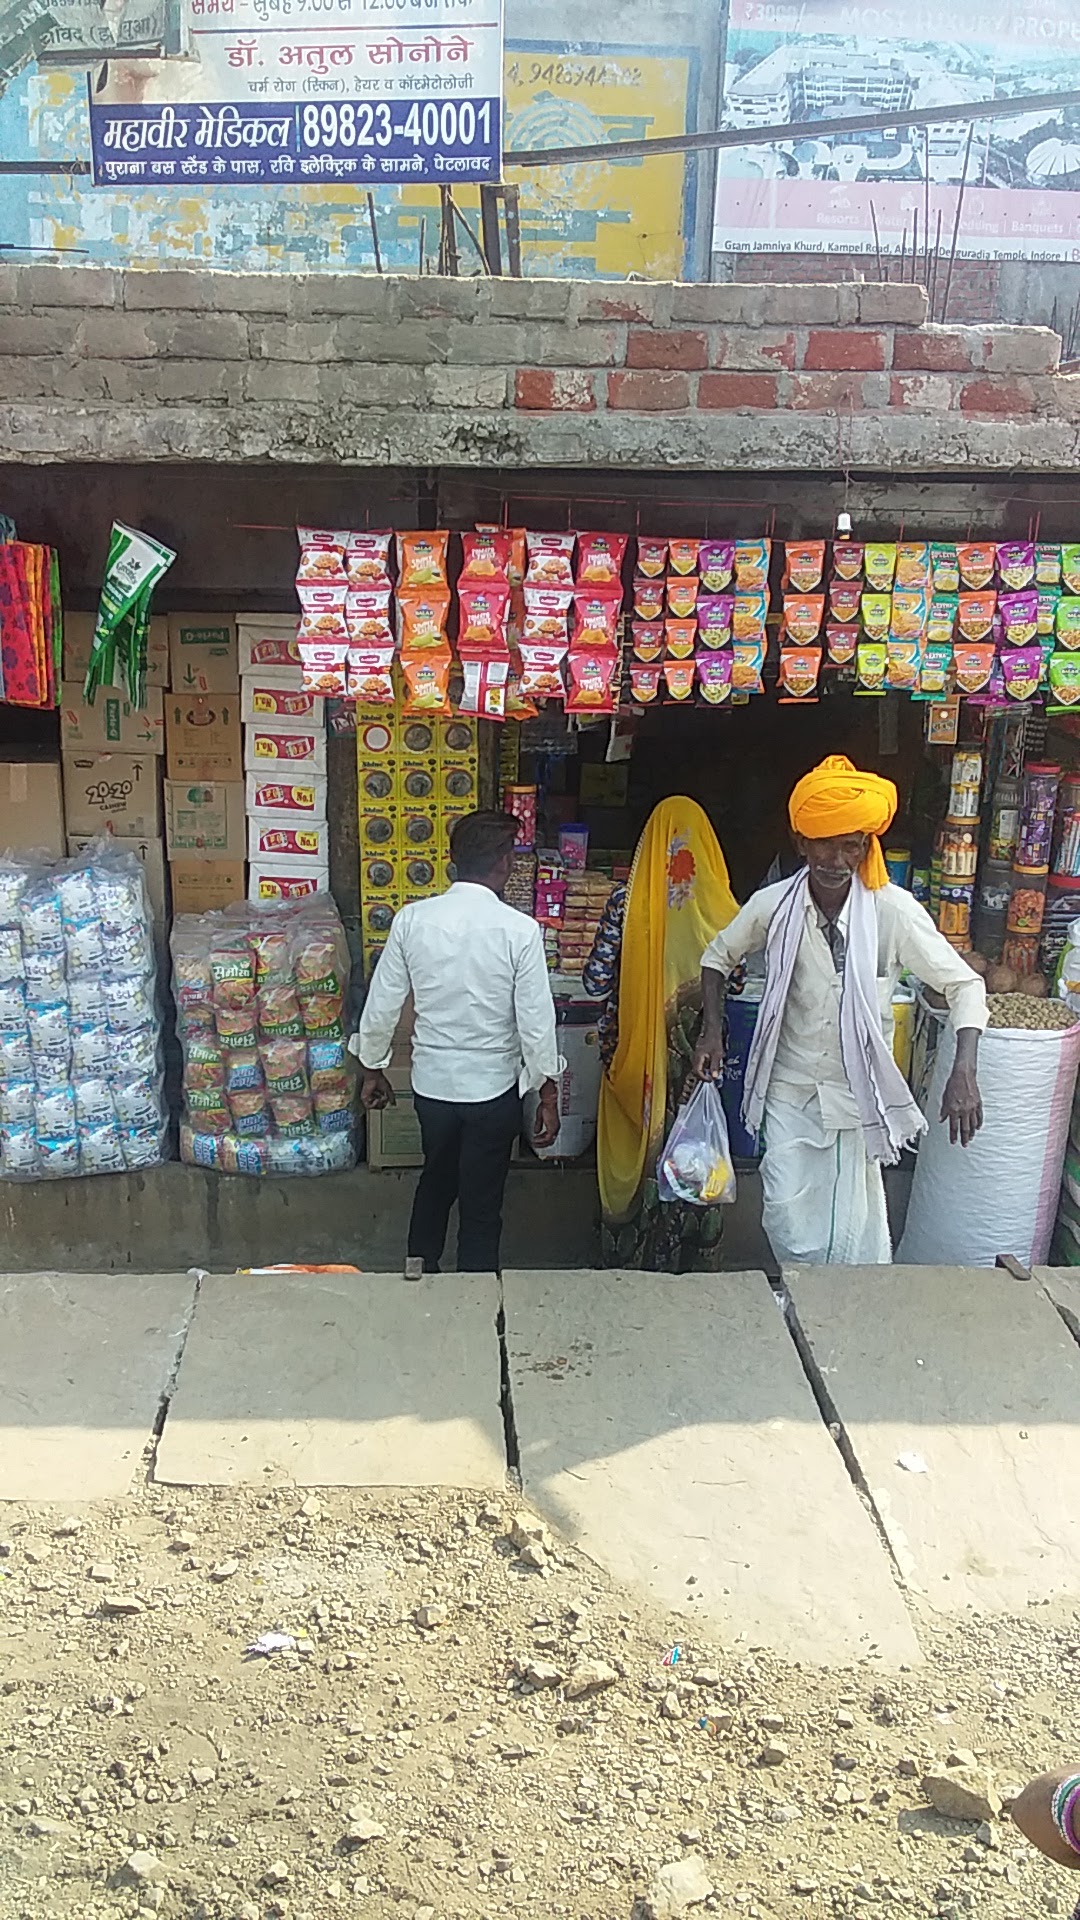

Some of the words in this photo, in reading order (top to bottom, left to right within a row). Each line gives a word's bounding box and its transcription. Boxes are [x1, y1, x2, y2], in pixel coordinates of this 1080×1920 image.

[225, 39, 264, 68] डॉ.
[279, 44, 356, 74] अतुल
[366, 34, 474, 66] सोनोने
[273, 79, 296, 94] रोग
[354, 75, 380, 92] हेयर
[384, 79, 394, 90] व
[104, 106, 191, 152] महावीर
[195, 105, 294, 150] मेडिकल
[303, 101, 492, 148] 89823-40001
[105, 159, 147, 182] पुराना
[151, 159, 175, 176] बस
[213, 154, 227, 174] के
[231, 159, 265, 177] पास,
[269, 154, 296, 174] रवि
[362, 154, 377, 173] के
[379, 153, 428, 175] सामने,
[433, 152, 493, 173] पेटलावद
[951, 218, 1000, 234] edding
[1011, 220, 1064, 234] Banquets
[724, 240, 751, 251] Gram
[752, 240, 792, 253] Jamniya
[794, 241, 825, 253] Khurd,
[828, 242, 863, 254] Kampel
[939, 246, 991, 259] Deguradia
[1031, 249, 1061, 261] Indore
[85, 779, 133, 805] 20-20
[213, 964, 251, 982] समोसा
